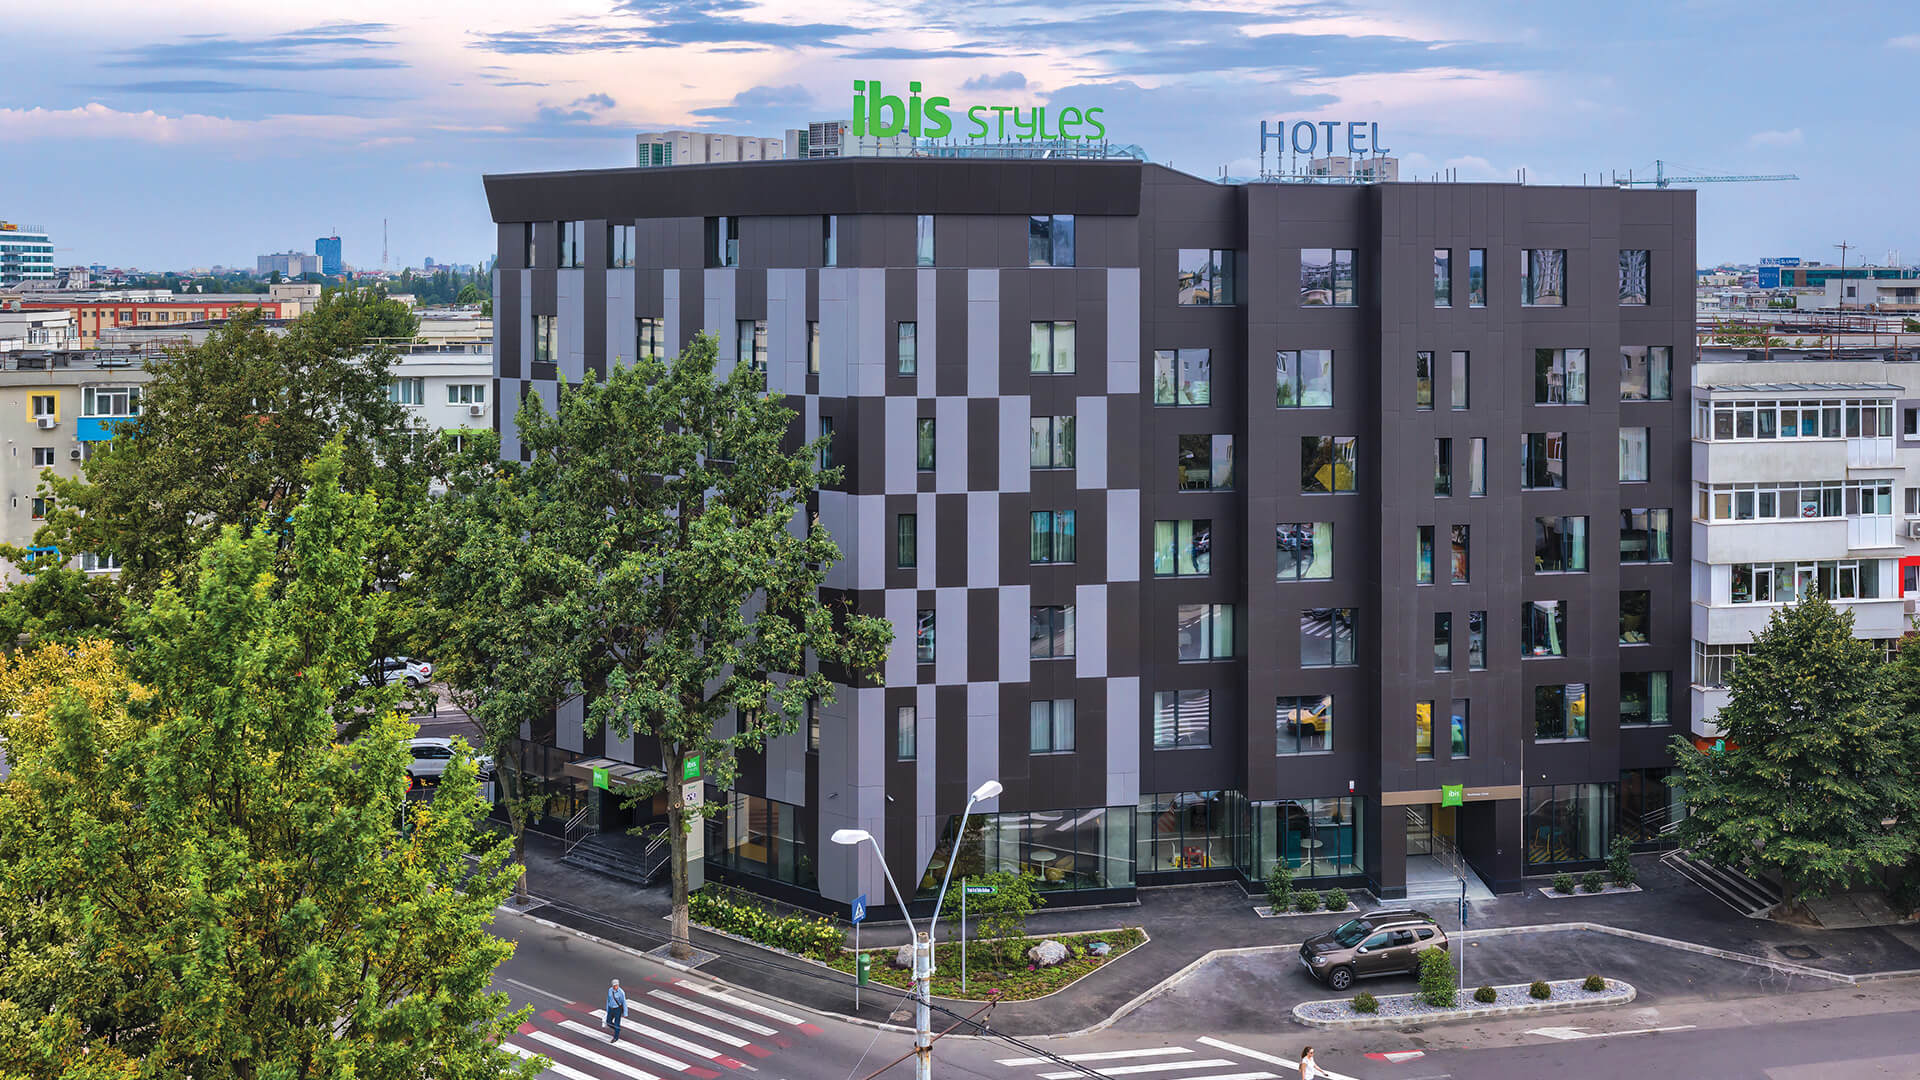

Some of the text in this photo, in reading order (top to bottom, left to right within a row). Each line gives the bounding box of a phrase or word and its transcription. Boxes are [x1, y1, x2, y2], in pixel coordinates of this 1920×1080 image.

[853, 80, 952, 138] ibis
[1261, 120, 1391, 153] HOTEL
[1448, 790, 1460, 798] ibis
